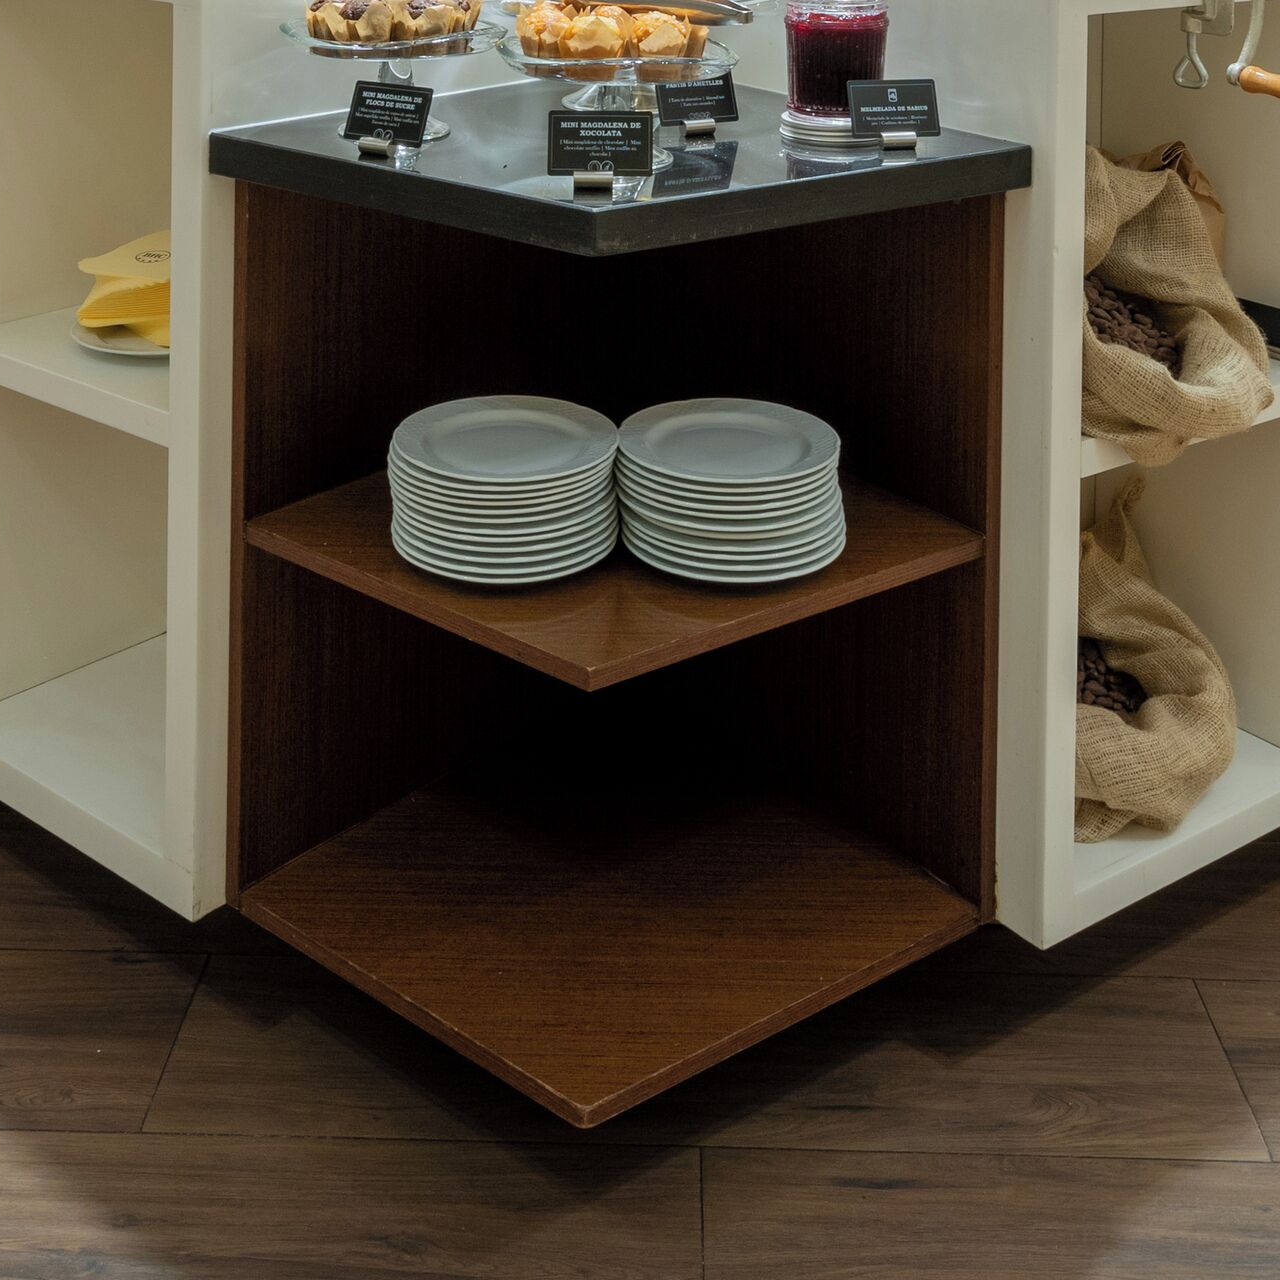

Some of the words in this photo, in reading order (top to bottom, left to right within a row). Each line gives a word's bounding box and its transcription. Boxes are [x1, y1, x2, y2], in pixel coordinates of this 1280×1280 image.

[376, 92, 412, 102] MAGDALENA
[365, 99, 385, 107] FLOCS
[385, 100, 395, 108] DE
[394, 102, 416, 110] SUCRE
